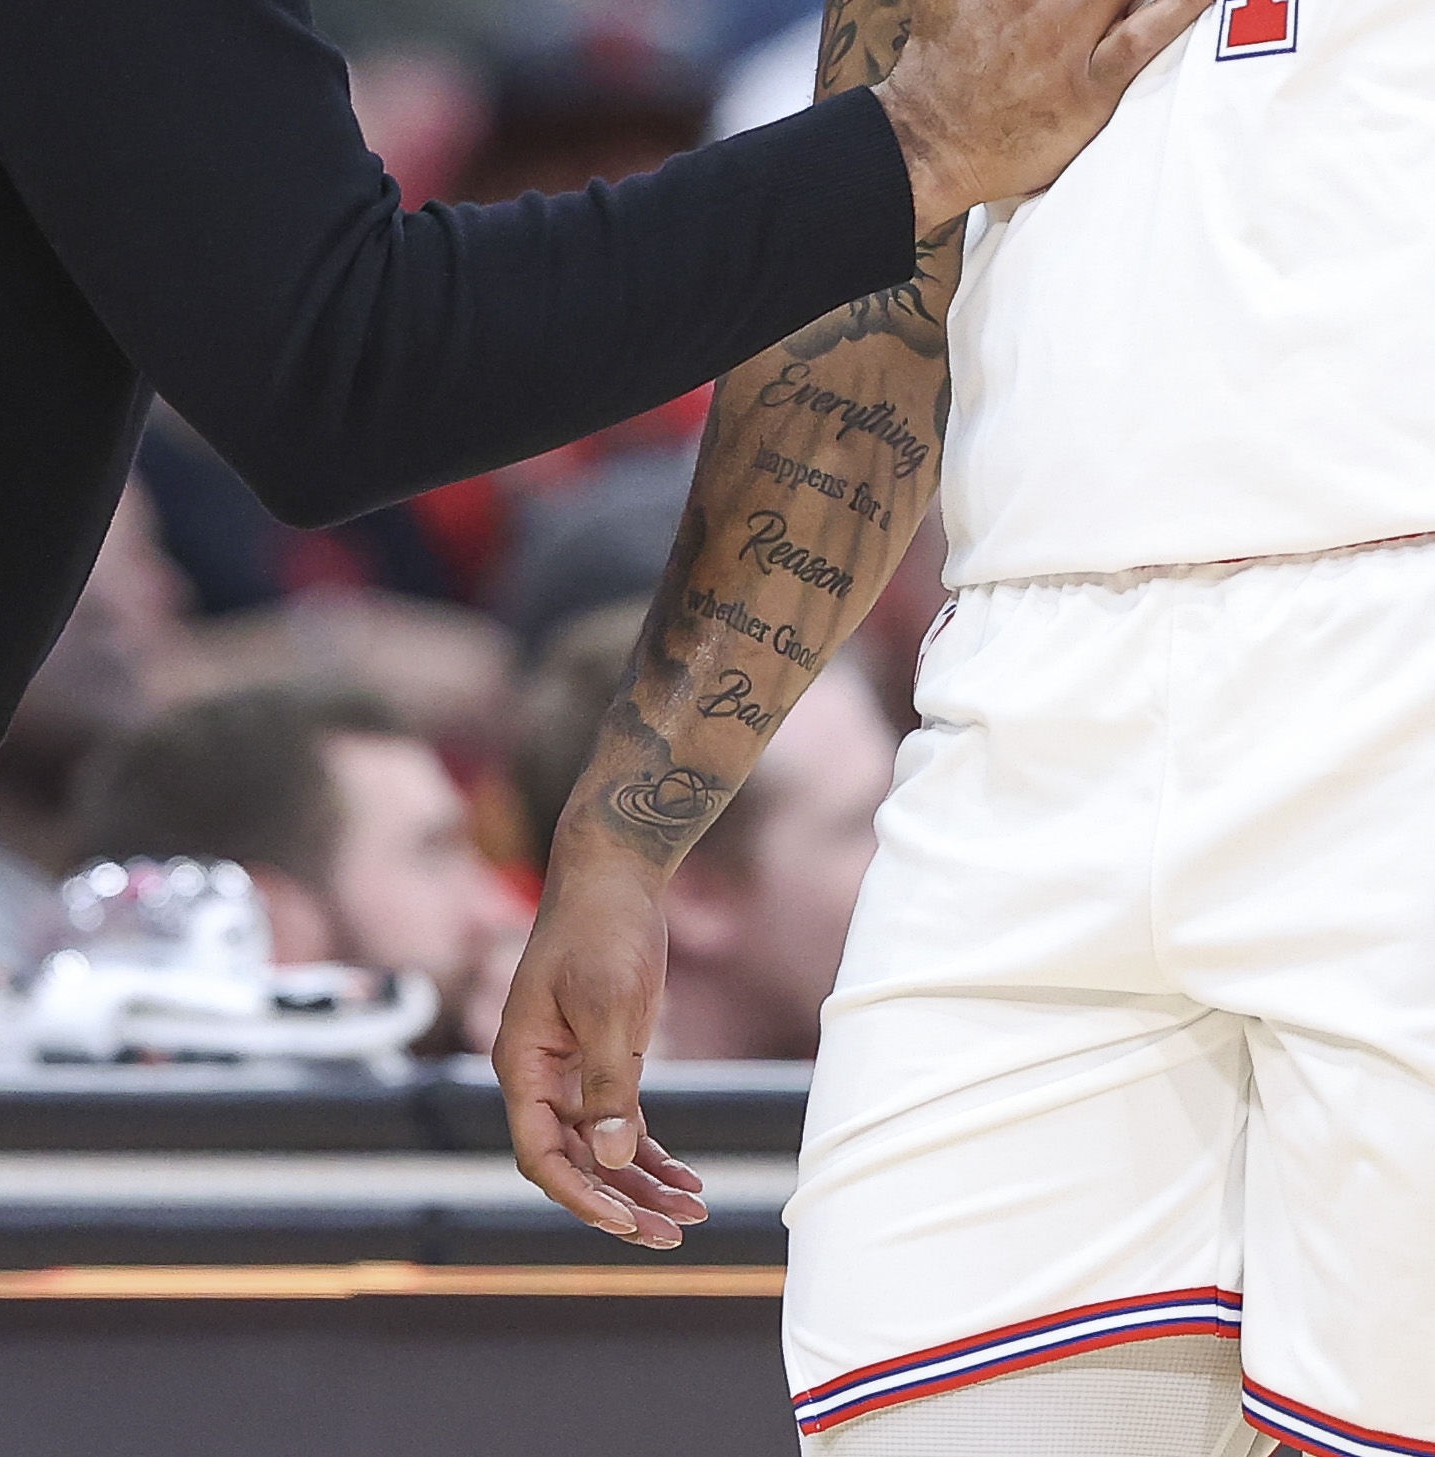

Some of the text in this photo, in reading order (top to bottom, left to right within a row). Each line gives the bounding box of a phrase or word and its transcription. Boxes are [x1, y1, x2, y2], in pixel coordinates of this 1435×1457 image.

[759, 362, 930, 480] Everything
[750, 435, 849, 500] happens
[847, 481, 882, 523] for
[738, 509, 855, 601] Reason
[686, 588, 772, 644] whether
